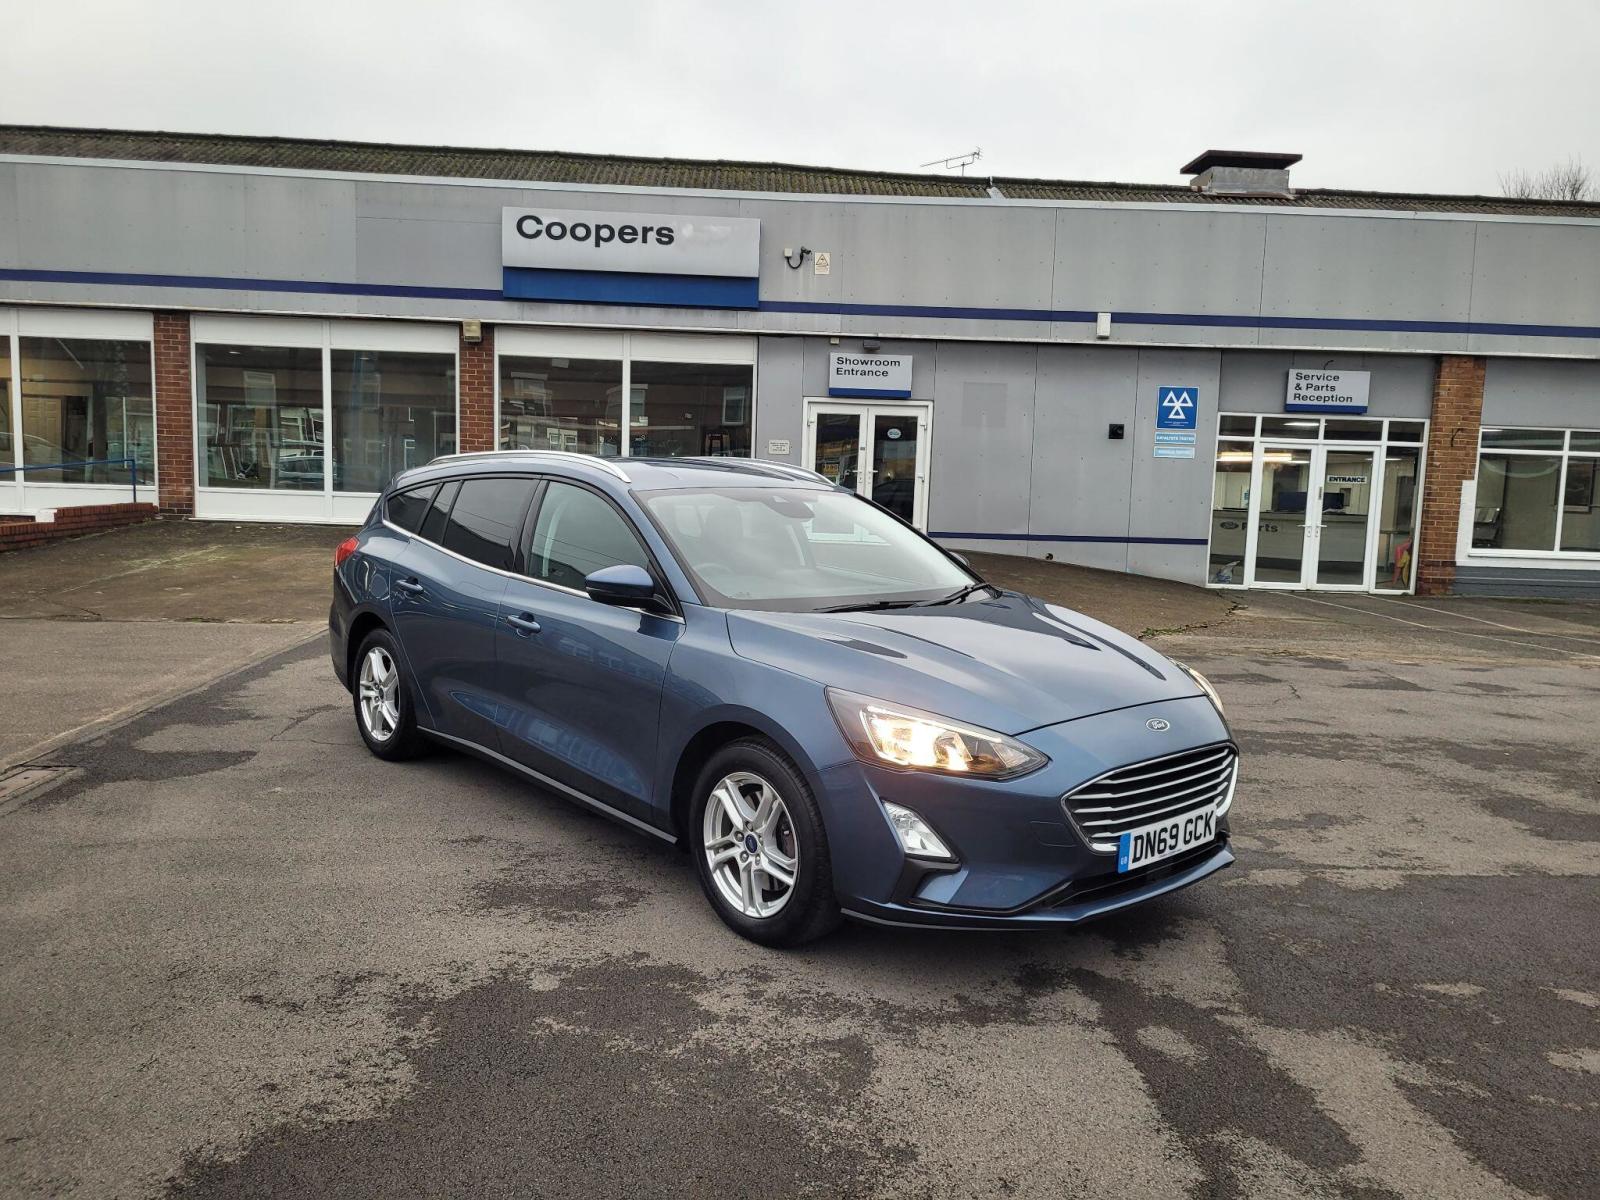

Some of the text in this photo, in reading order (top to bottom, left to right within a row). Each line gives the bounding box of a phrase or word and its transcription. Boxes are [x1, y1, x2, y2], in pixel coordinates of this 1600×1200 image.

[516, 214, 675, 248] Coopers
[836, 355, 901, 368] Showroom
[836, 367, 889, 378] Entrance
[1295, 372, 1340, 382] Service
[1294, 383, 1336, 392] & Parts
[1293, 392, 1353, 403] Reception
[1241, 521, 1279, 532] Prts
[1132, 810, 1215, 864] DN69 GCK
